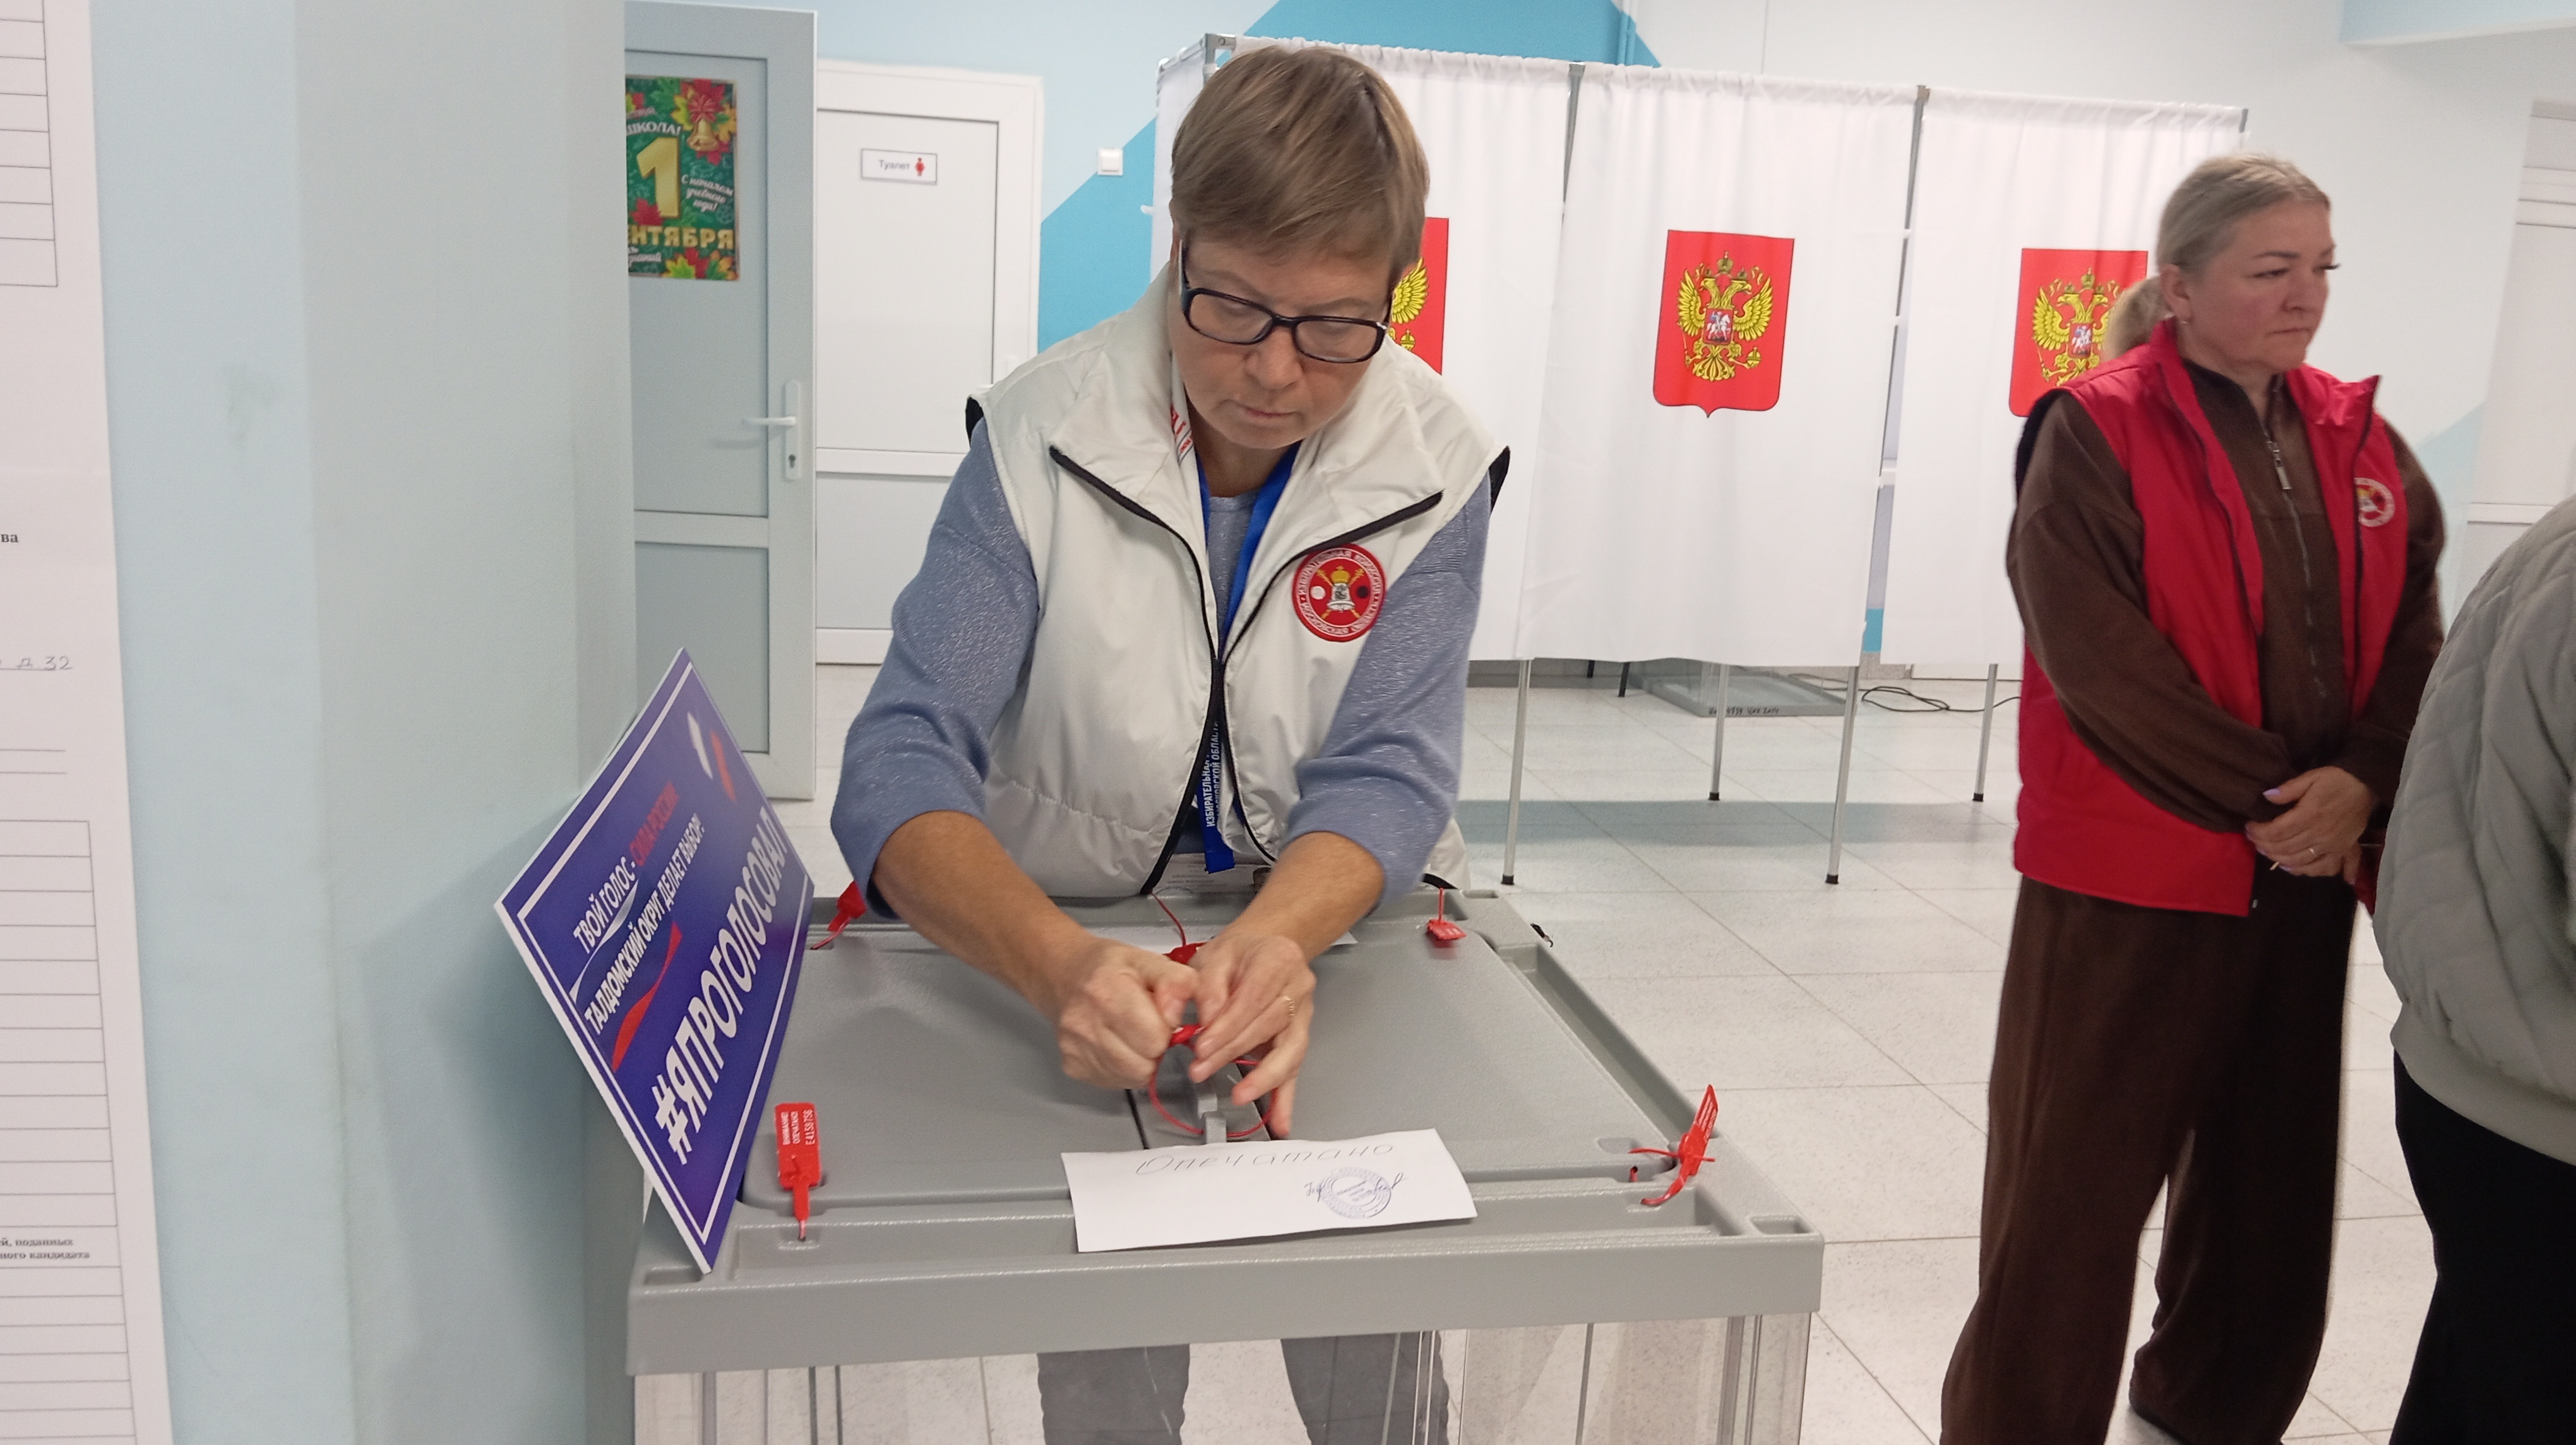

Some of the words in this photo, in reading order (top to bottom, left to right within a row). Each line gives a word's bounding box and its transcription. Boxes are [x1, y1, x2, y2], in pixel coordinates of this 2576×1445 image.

[636, 137, 680, 218] 1
[880, 160, 910, 171] Туалет
[628, 225, 734, 249] НТЯБРЯ
[45, 656, 73, 670] 32
[573, 894, 607, 954] ТВОЙ
[599, 856, 636, 920] ГОЛОС
[584, 921, 647, 1036] ТАЛДОМСКИЙ
[638, 890, 665, 943] ОКРУГ
[657, 846, 688, 911] ДЕЛАЕТ
[678, 812, 705, 865] ВЫБОР!
[652, 806, 787, 1165] #ЯПРОГОЛОСОВАЛ
[1136, 1144, 1393, 1175] Опечатано
[30, 1252, 90, 1260] кандидата
